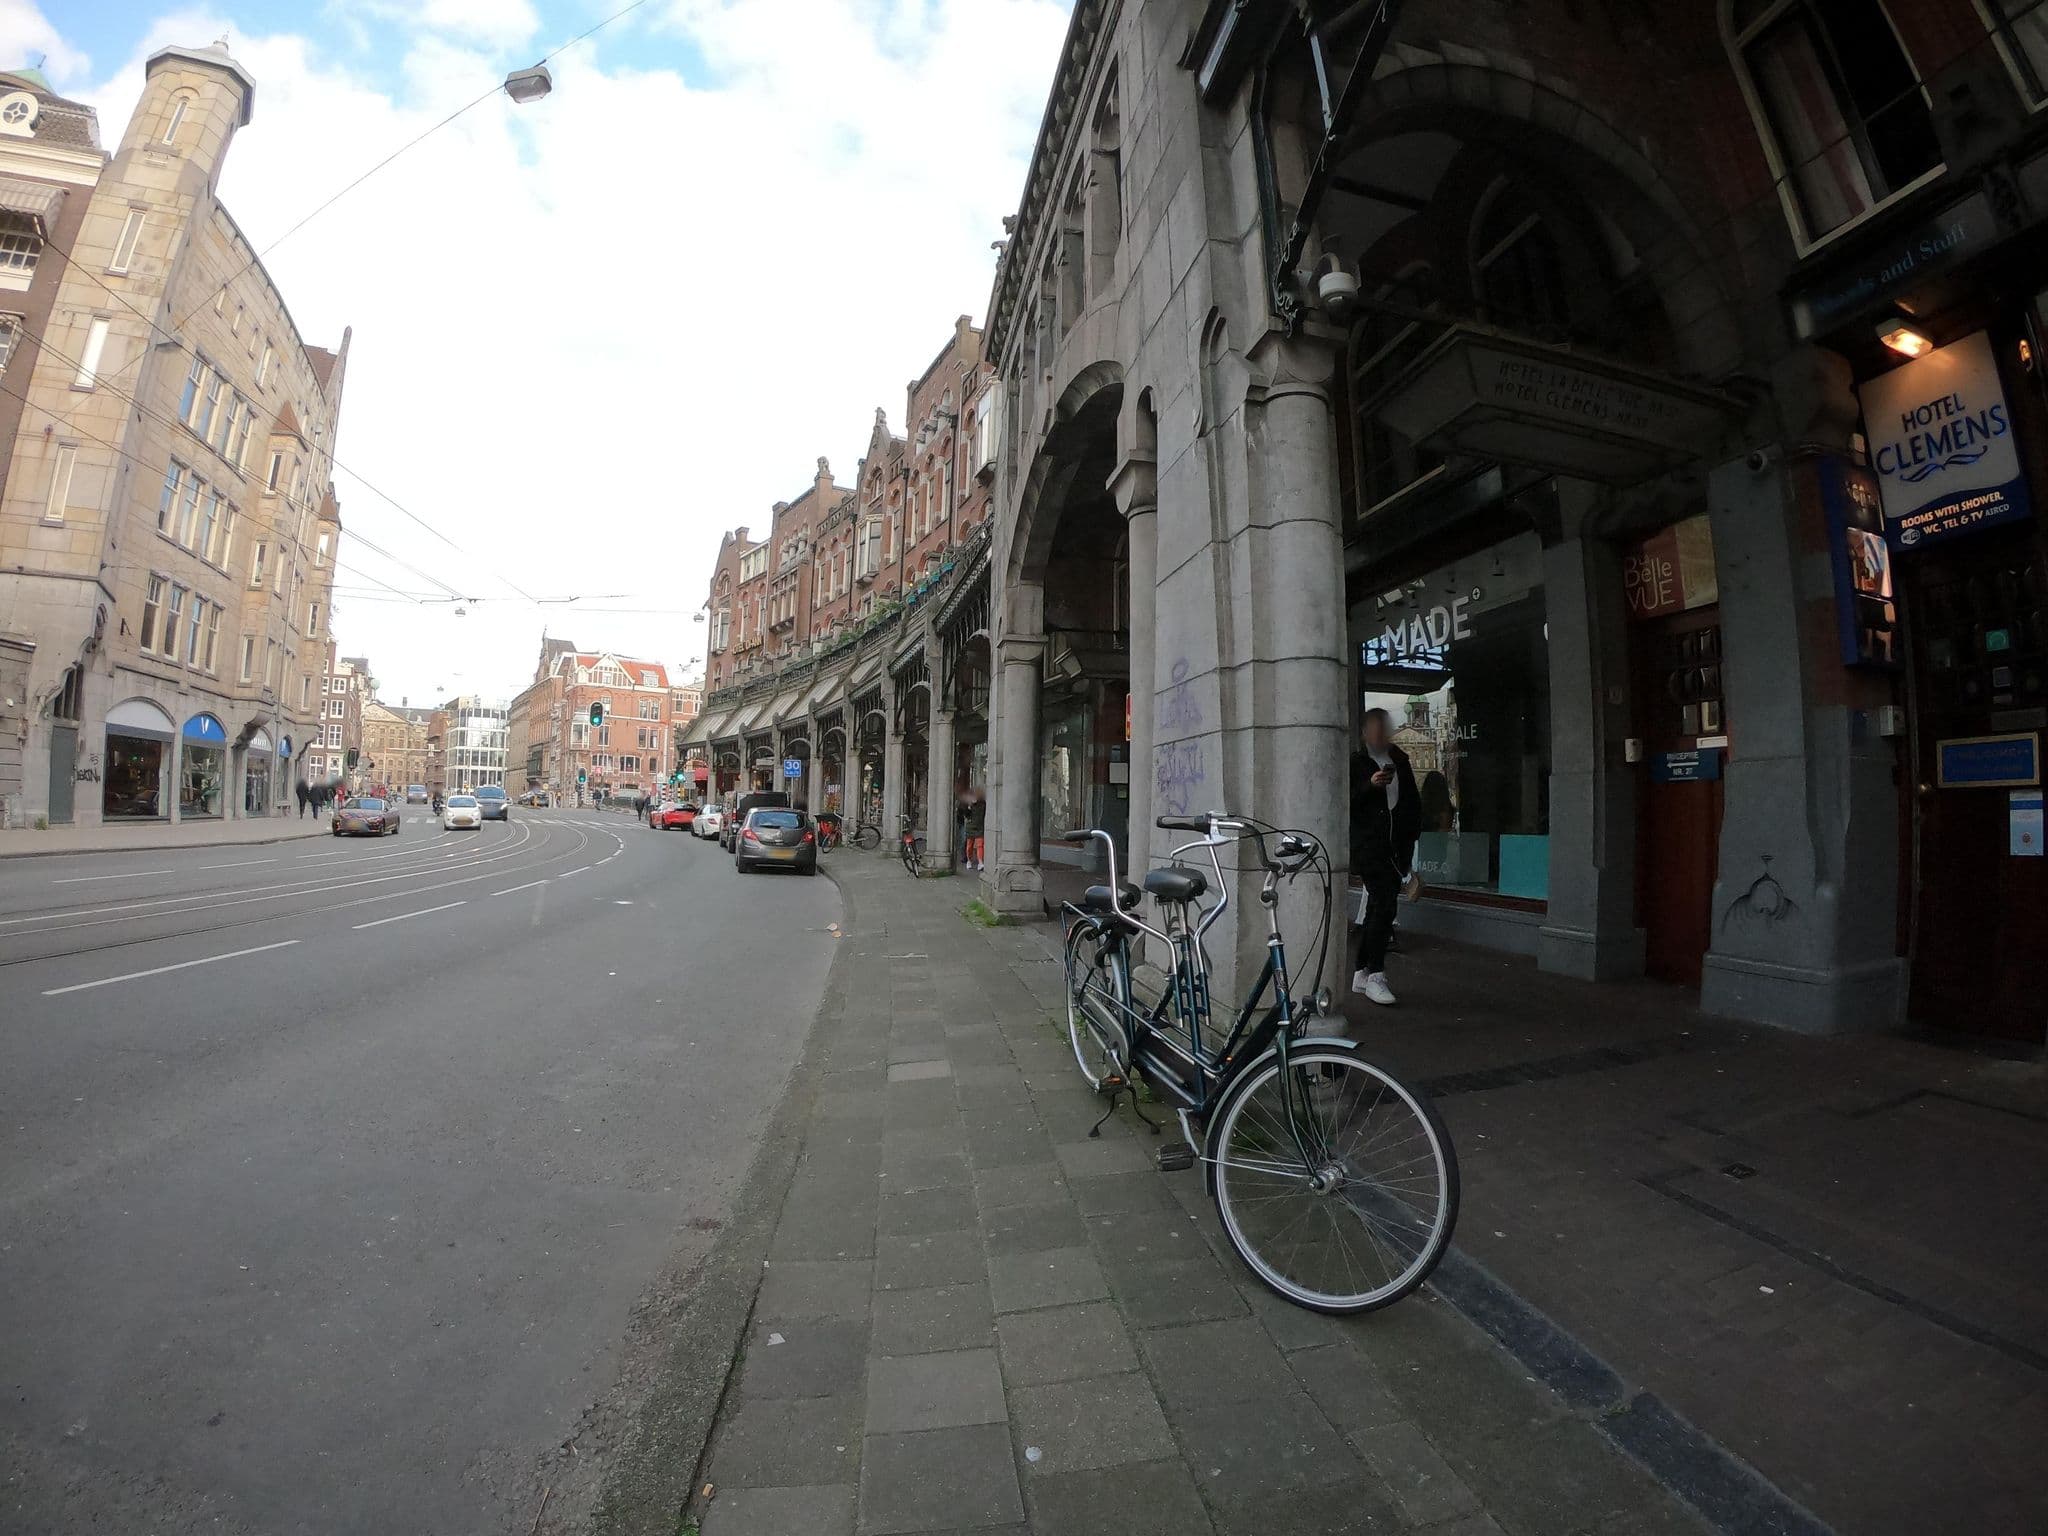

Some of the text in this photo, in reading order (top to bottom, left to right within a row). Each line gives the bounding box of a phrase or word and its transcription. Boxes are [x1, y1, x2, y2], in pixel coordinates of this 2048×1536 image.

[1881, 250, 1915, 283] and
[1901, 393, 1965, 432] HOTEL
[1876, 405, 2007, 475] CLEMENS
[1902, 511, 1934, 528] ROOMS
[1935, 504, 1960, 518] WITH
[1923, 523, 1942, 534] WC,
[1943, 518, 1959, 530] TEL
[1960, 515, 1969, 525] &
[1970, 510, 1983, 522] TV
[1624, 556, 1672, 588] Belle
[1627, 578, 1675, 611] VUE
[1385, 595, 1471, 661] MADE
[1448, 724, 1478, 743] SALE
[786, 761, 800, 770] 30
